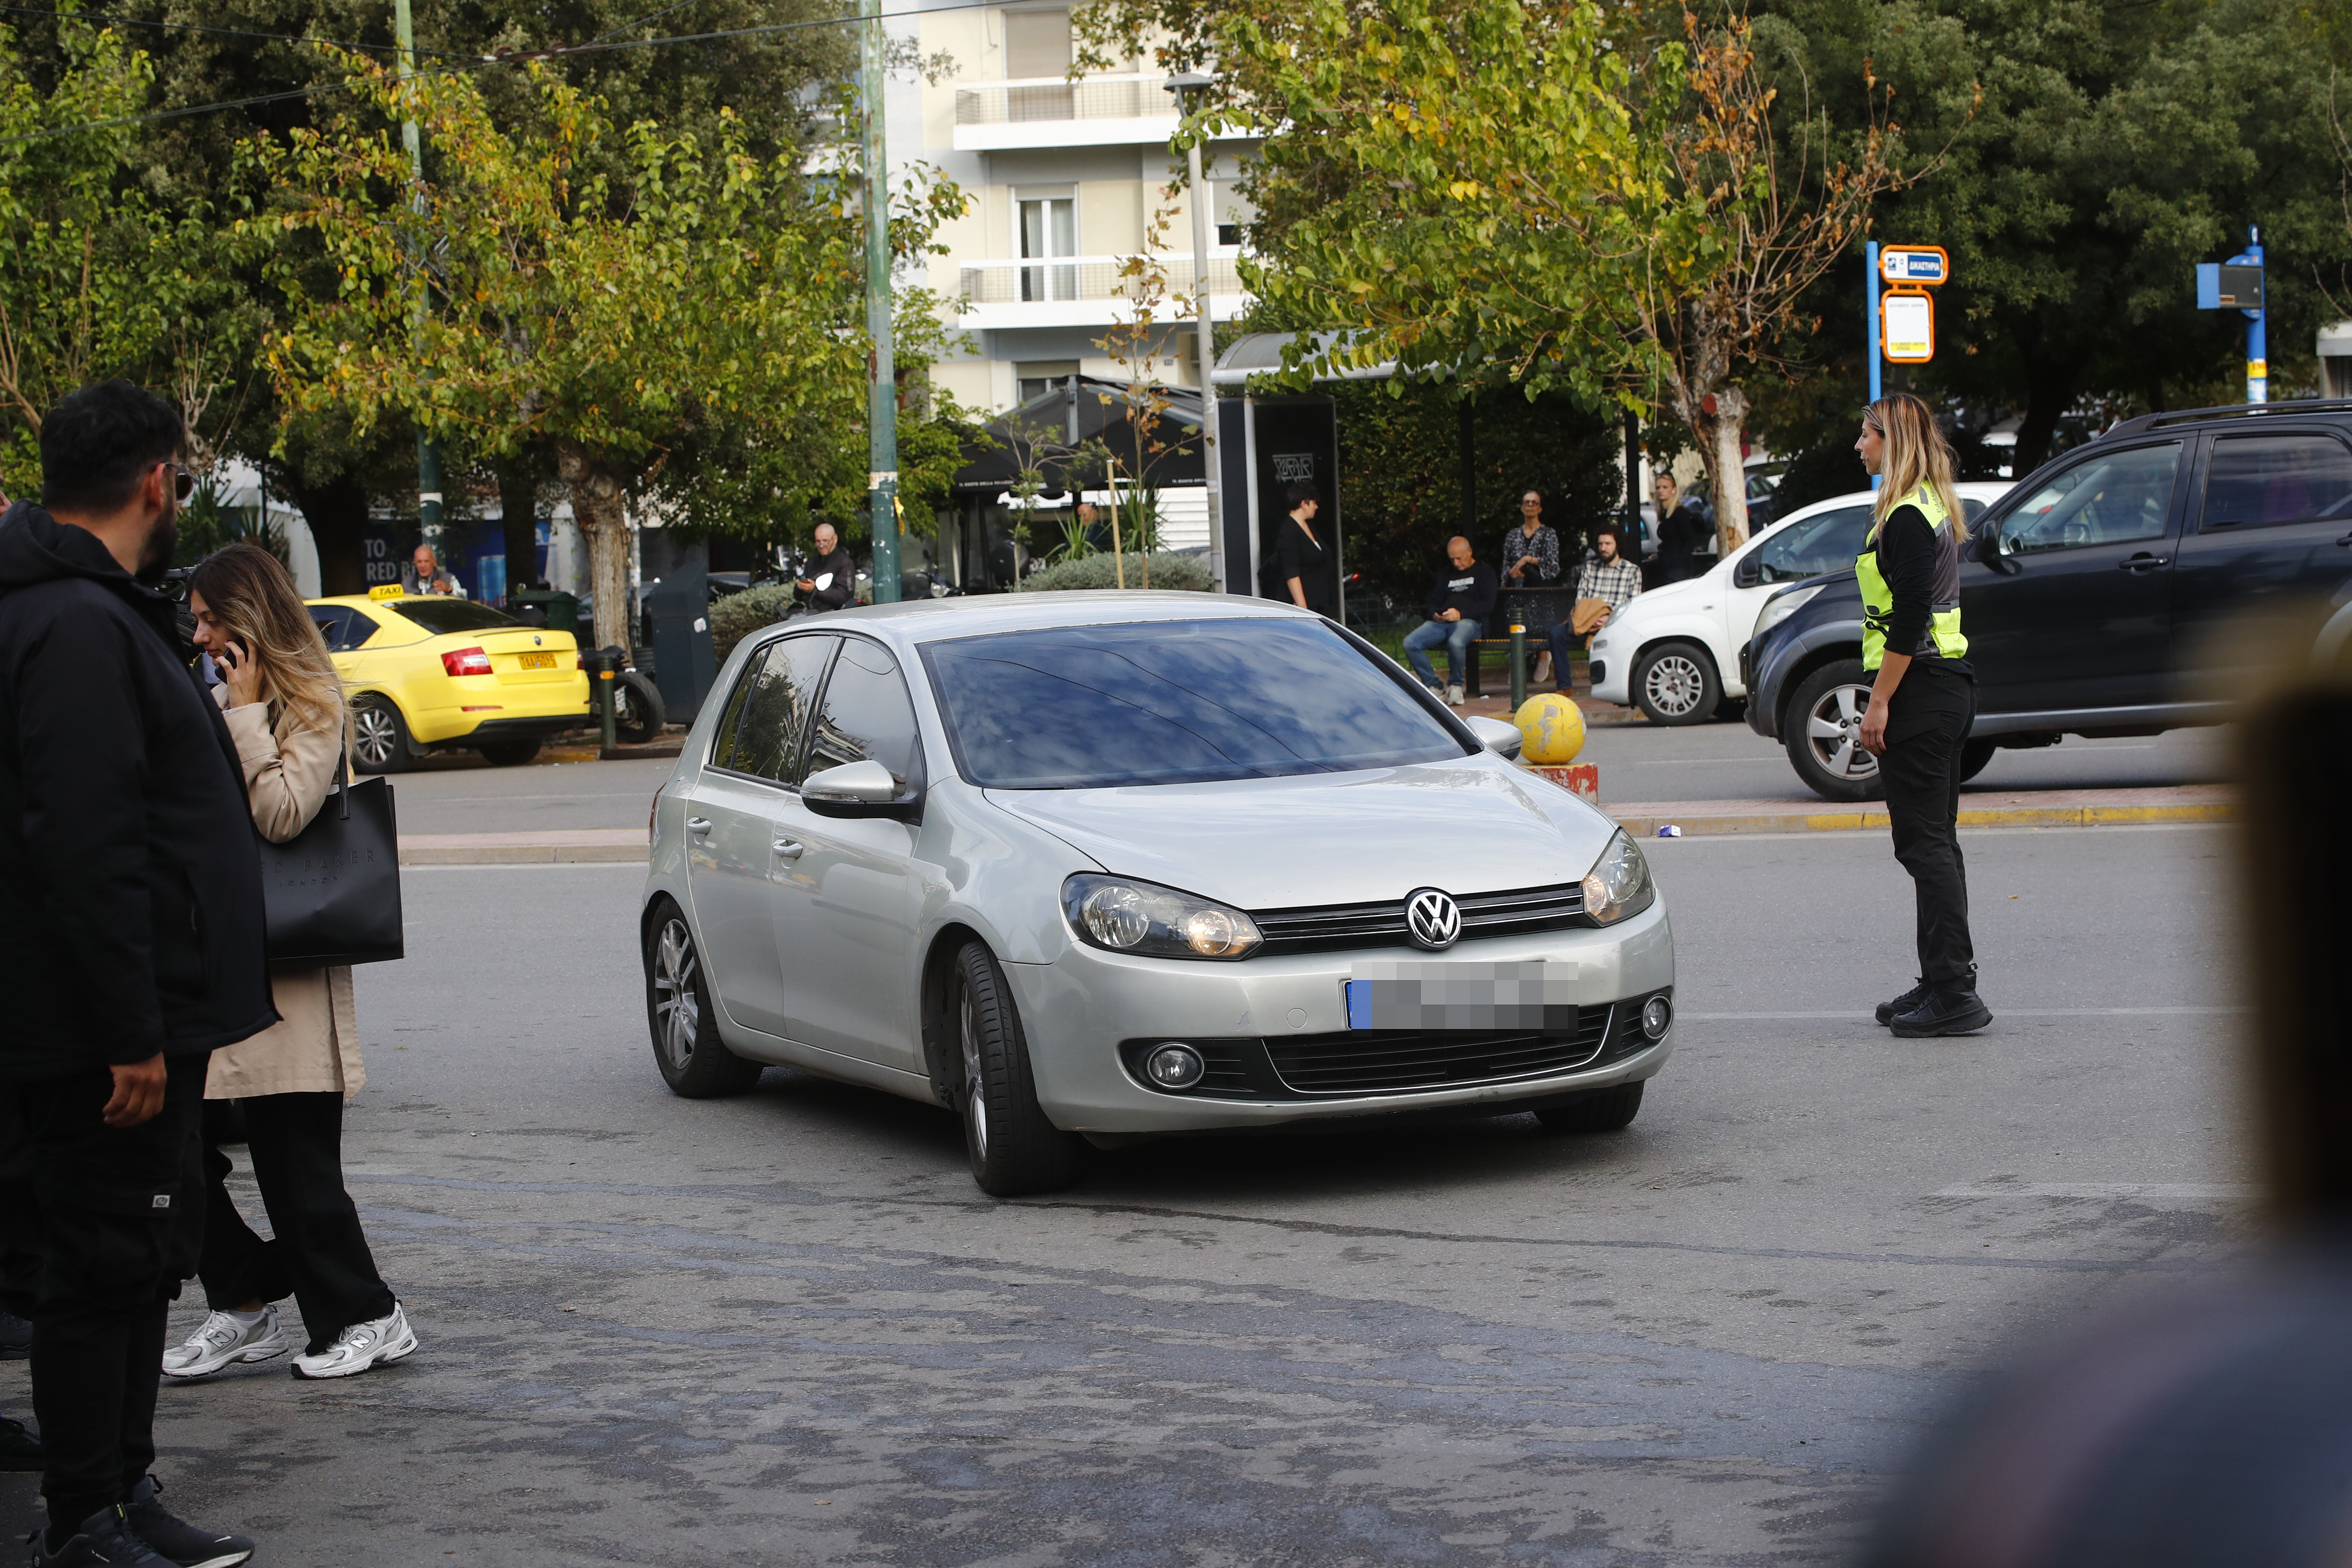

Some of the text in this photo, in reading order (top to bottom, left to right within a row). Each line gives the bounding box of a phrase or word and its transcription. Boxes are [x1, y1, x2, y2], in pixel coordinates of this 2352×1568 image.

[364, 538, 386, 559] TO
[366, 561, 397, 582] RED
[379, 586, 401, 596] TAXI
[303, 848, 375, 872] BAKER
[279, 875, 339, 887] LONDON
[1408, 891, 1461, 944] VW
[210, 1331, 231, 1348] N
[349, 1333, 371, 1350] N
